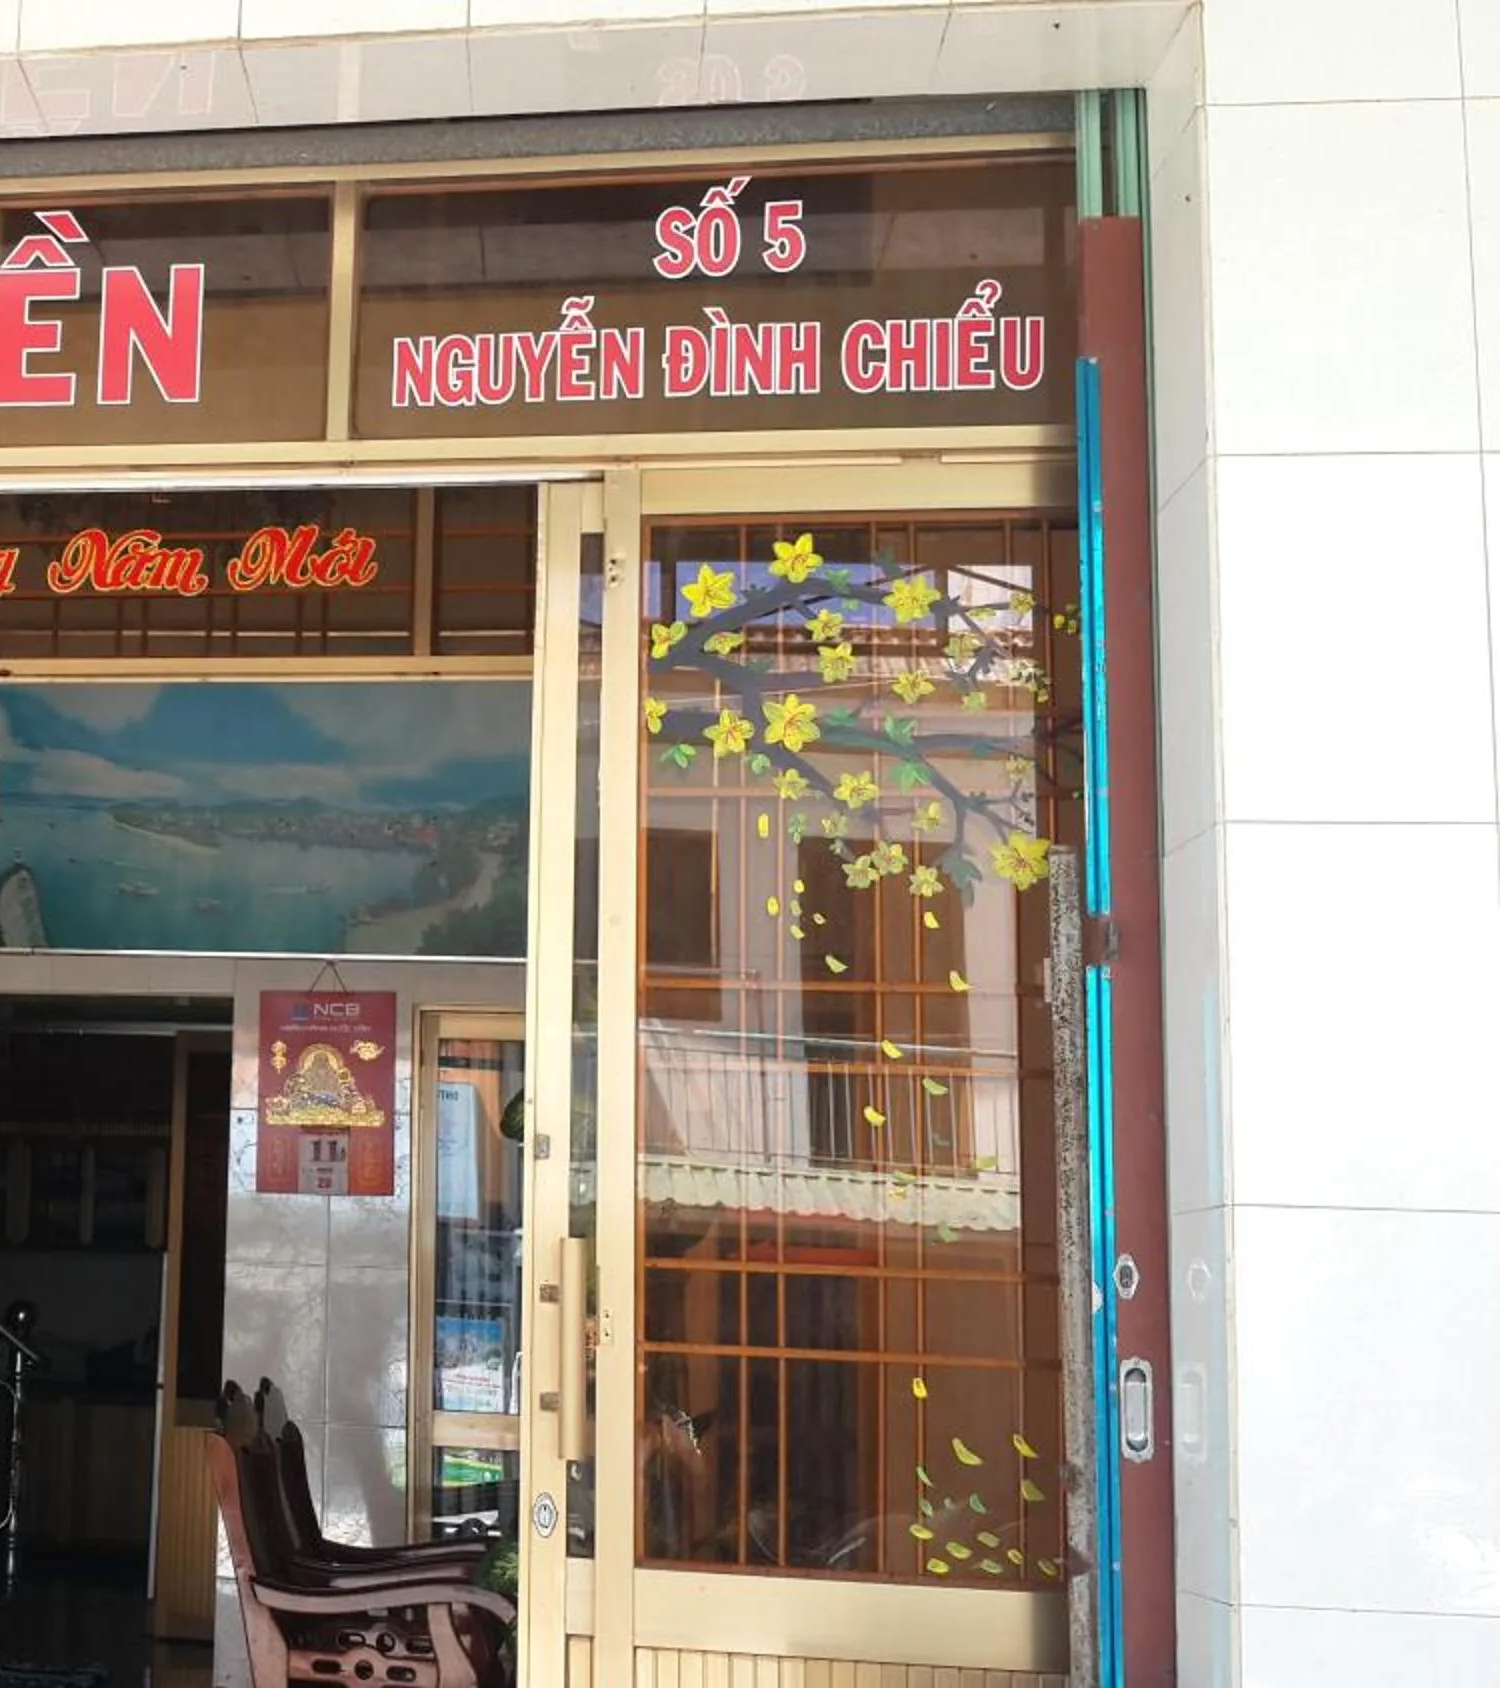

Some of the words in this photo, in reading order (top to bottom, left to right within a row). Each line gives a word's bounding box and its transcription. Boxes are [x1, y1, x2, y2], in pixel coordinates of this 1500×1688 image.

[651, 176, 752, 280] SỐ
[762, 200, 807, 273] 5
[391, 295, 645, 408] NGUYỄN
[663, 306, 821, 398] ĐÌNH
[841, 279, 1046, 394] CHIỂU
[48, 527, 209, 597] Năm
[227, 524, 379, 591] Mới
[313, 1003, 360, 1017] NCB
